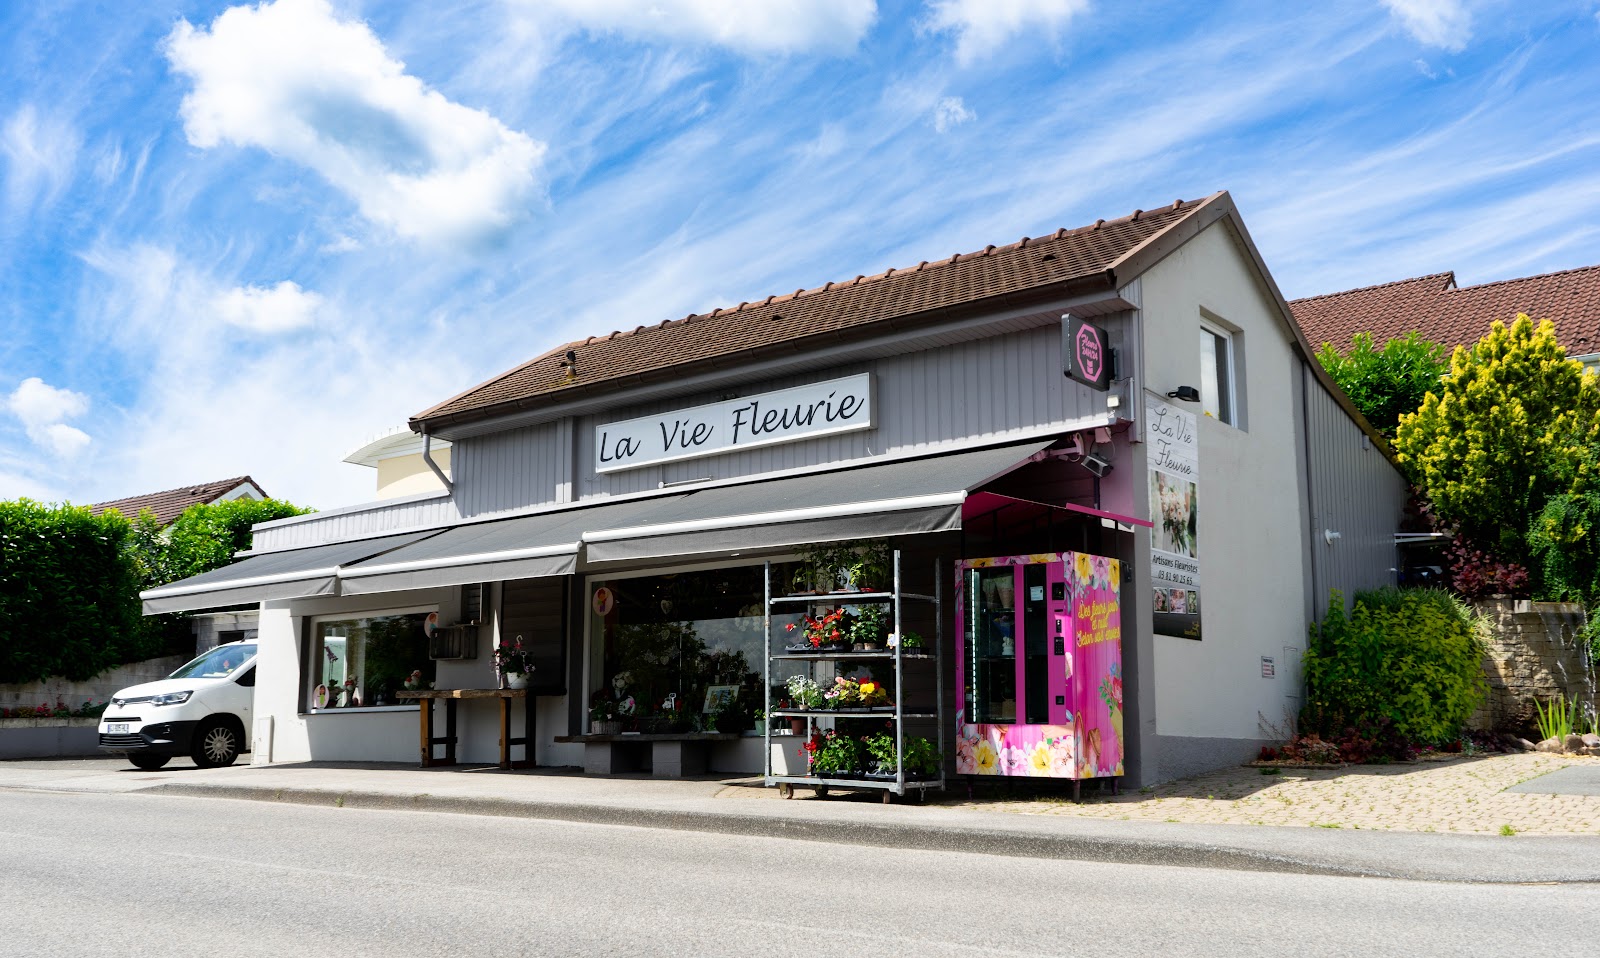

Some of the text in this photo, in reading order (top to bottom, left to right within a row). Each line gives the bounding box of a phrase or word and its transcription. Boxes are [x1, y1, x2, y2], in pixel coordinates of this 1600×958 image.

[600, 390, 865, 463] La Vie Fleurie
[1152, 407, 1192, 444] La Vie
[1155, 438, 1192, 475] Fleurie
[1152, 554, 1198, 574] Artisans Fleuristes
